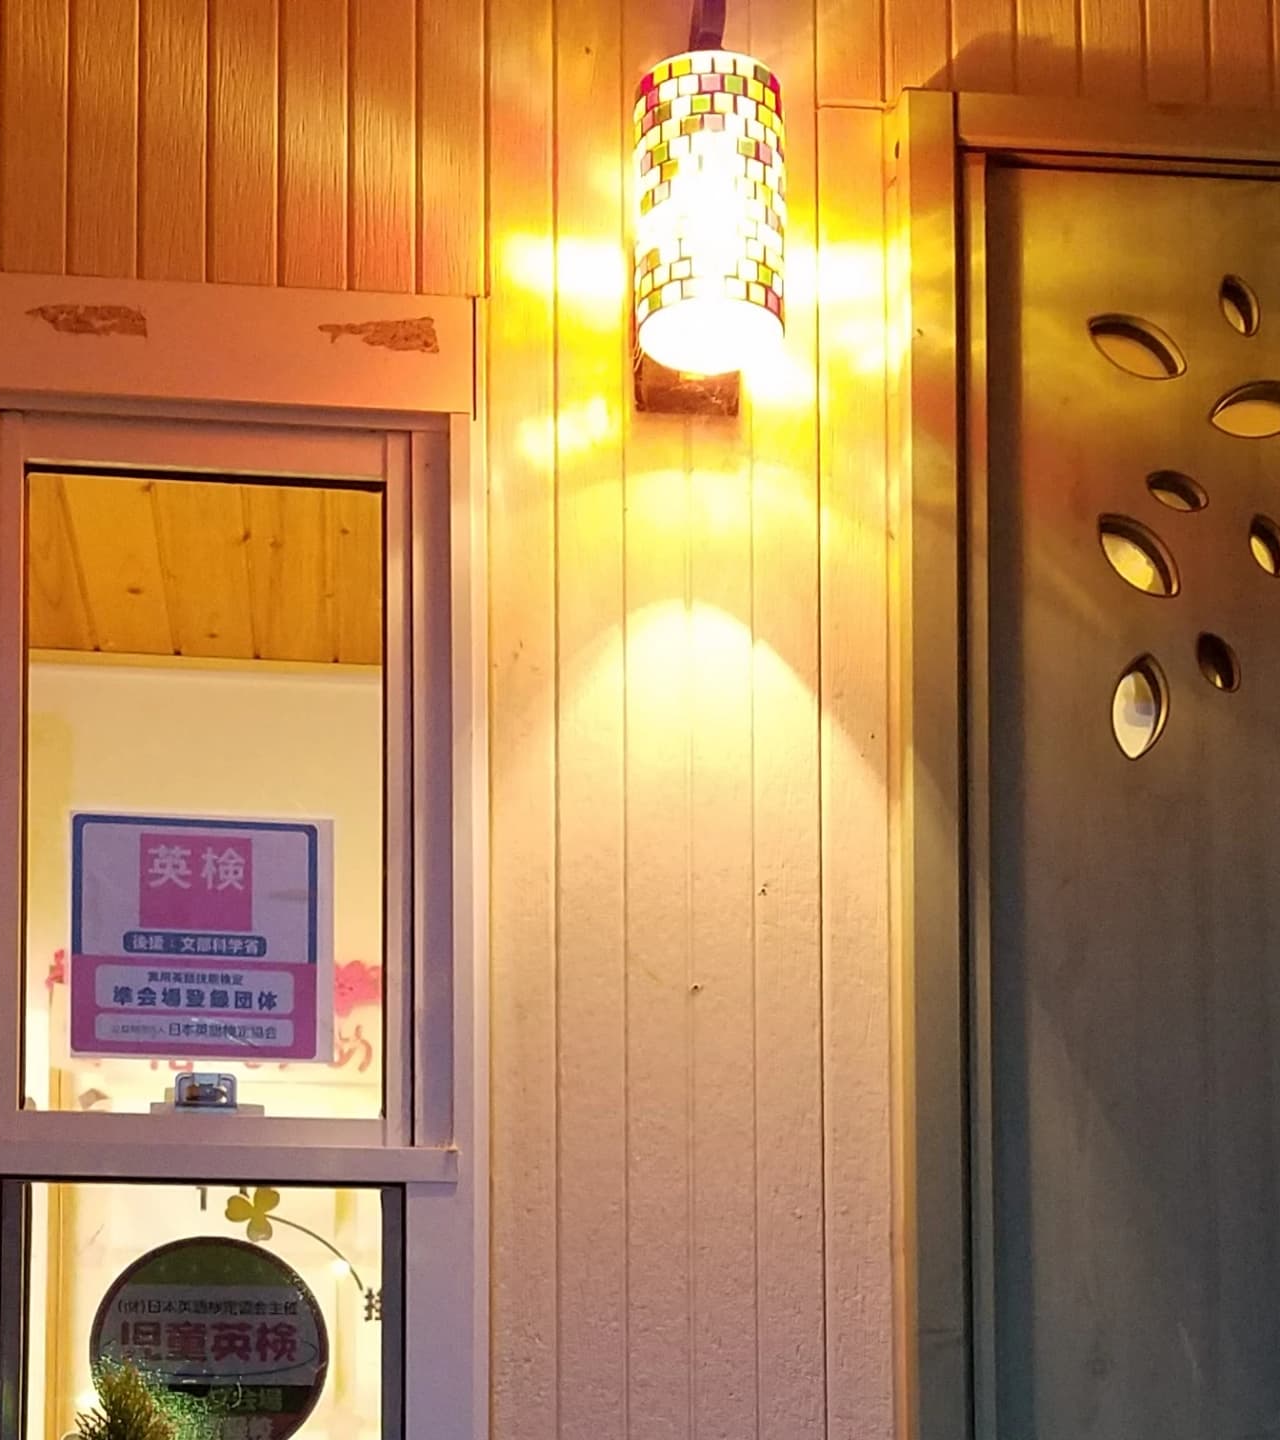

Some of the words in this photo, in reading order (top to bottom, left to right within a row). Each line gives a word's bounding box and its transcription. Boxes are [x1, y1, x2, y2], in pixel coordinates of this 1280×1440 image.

[147, 842, 247, 891] 英検
[113, 985, 278, 1011] 準会場登録団体
[120, 1321, 297, 1362] 児童英検
